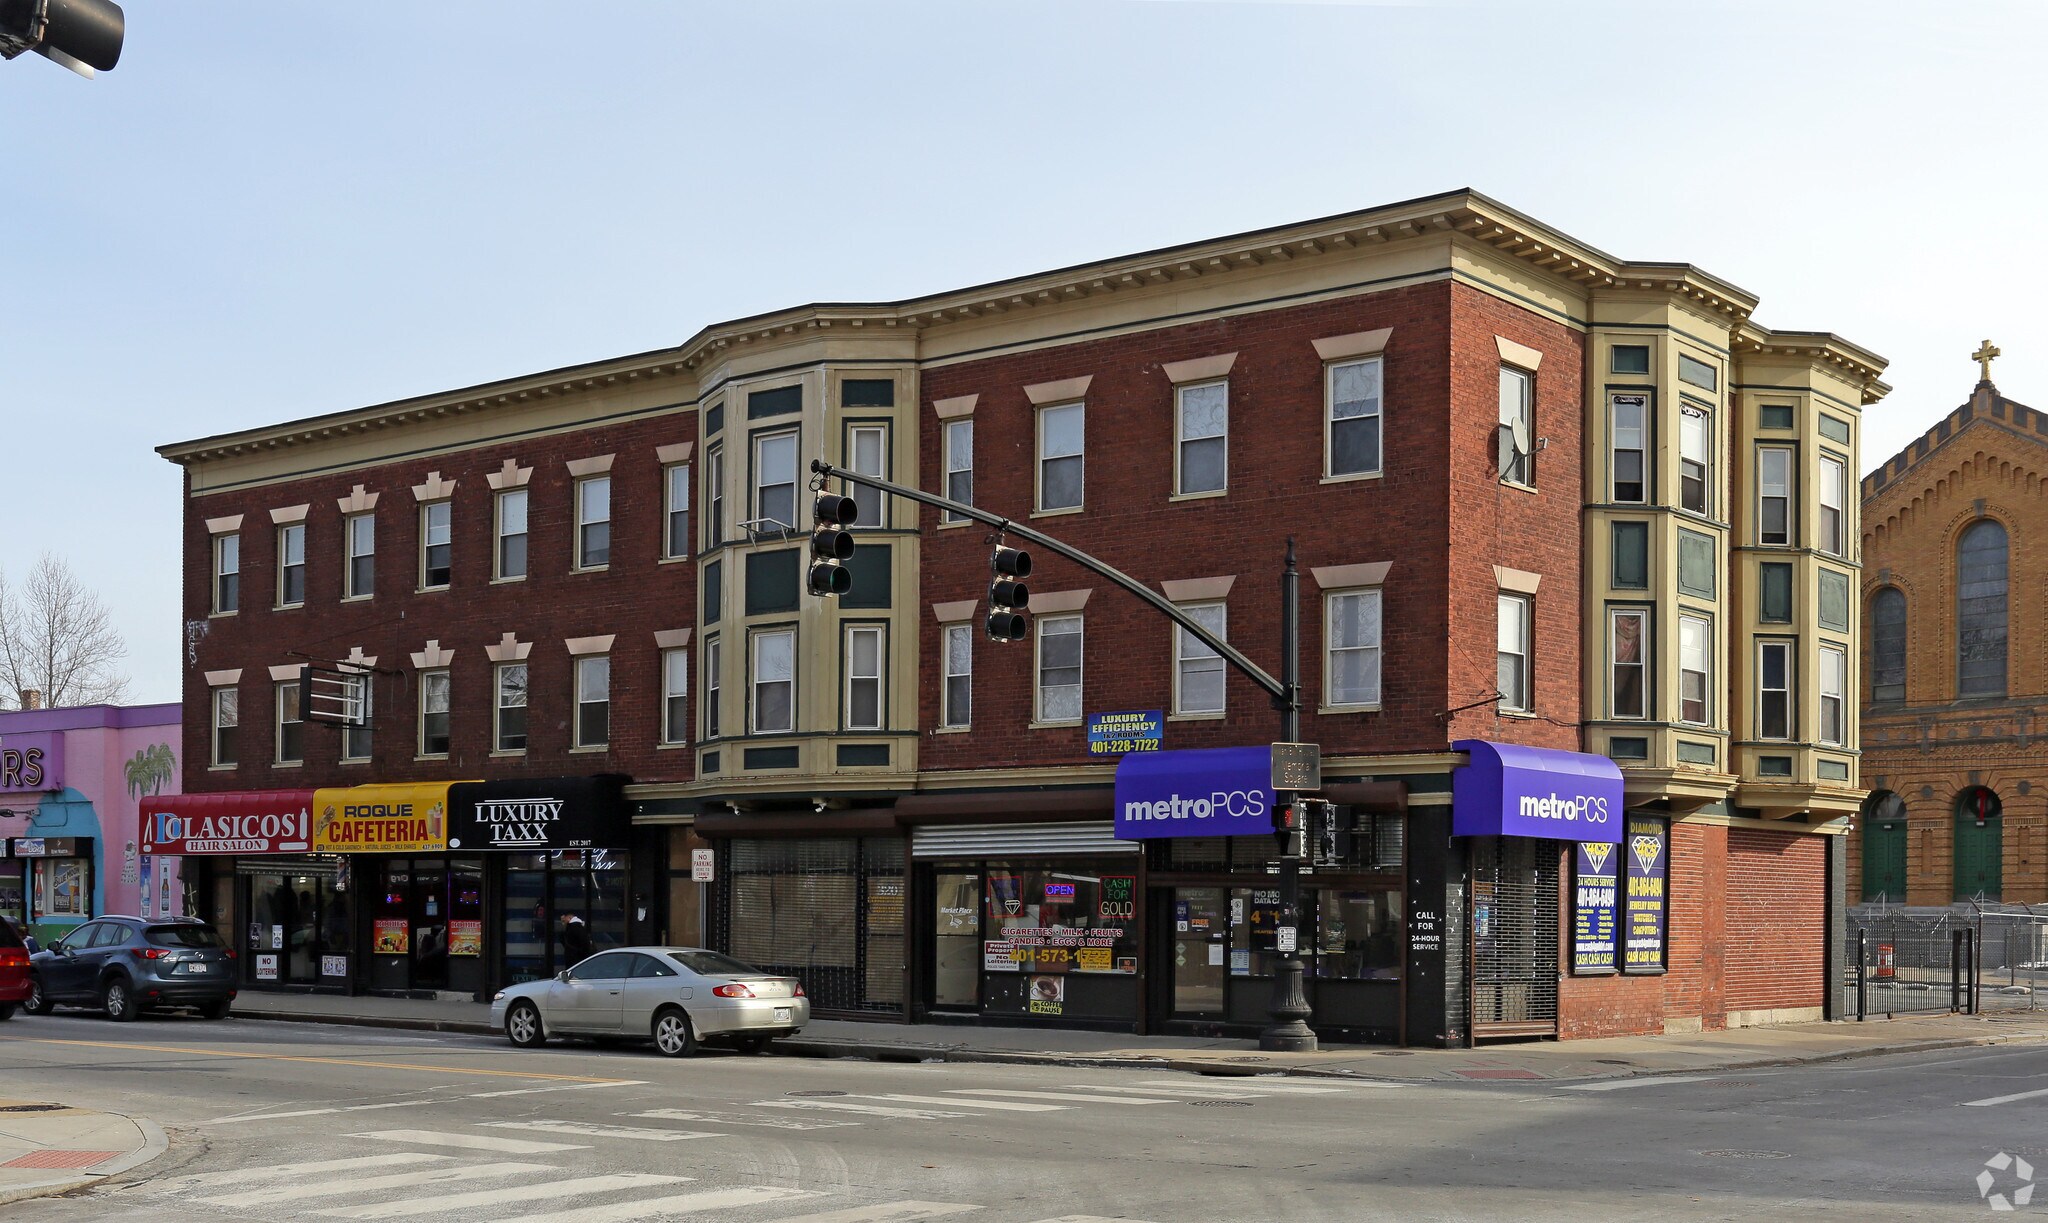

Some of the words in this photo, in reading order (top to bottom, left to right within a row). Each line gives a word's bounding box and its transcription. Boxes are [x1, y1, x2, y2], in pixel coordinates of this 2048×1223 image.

[1101, 713, 1146, 723] LUXURY
[1092, 721, 1157, 733] EFFICIENCY
[1091, 738, 1159, 753] 401-228-7722
[0, 748, 44, 787] RS
[1125, 789, 1264, 821] metroPCS
[1519, 792, 1608, 823] metroPCS
[344, 804, 413, 818] ROQUE
[474, 803, 564, 823] LUXURY
[328, 819, 429, 843] CAFETERIA
[490, 822, 549, 841] TAXX
[1630, 823, 1663, 834] DIAMOND
[190, 841, 221, 851] HAIR
[223, 839, 263, 851] SALON
[1104, 878, 1132, 888] CASH
[1584, 878, 1599, 886] HOURS
[1599, 878, 1616, 887] SERVICE
[1045, 885, 1075, 894] OPEN
[1107, 889, 1129, 899] FOR
[1254, 890, 1266, 898] NO
[1267, 890, 1280, 898] MO
[940, 906, 959, 914] Market
[1100, 901, 1134, 915] GOLD
[1416, 911, 1436, 919] CALL
[1417, 922, 1434, 930] FOR
[1001, 927, 1053, 936] CIGARETTES
[1061, 928, 1084, 936] MILK
[1090, 928, 1123, 937] FRUITS
[1008, 937, 1045, 946] CANDIES
[1053, 937, 1077, 946] EGGS
[1078, 937, 1085, 945] &
[1086, 937, 1114, 946] MORE
[262, 957, 271, 965] NO
[1576, 953, 1588, 965] CASH
[1588, 953, 1601, 965] CASH
[1601, 953, 1614, 965] CASH
[1626, 951, 1639, 962] CASH
[1638, 951, 1650, 962] CASH
[1649, 951, 1661, 962] CASH
[256, 967, 277, 976] LOITERING
